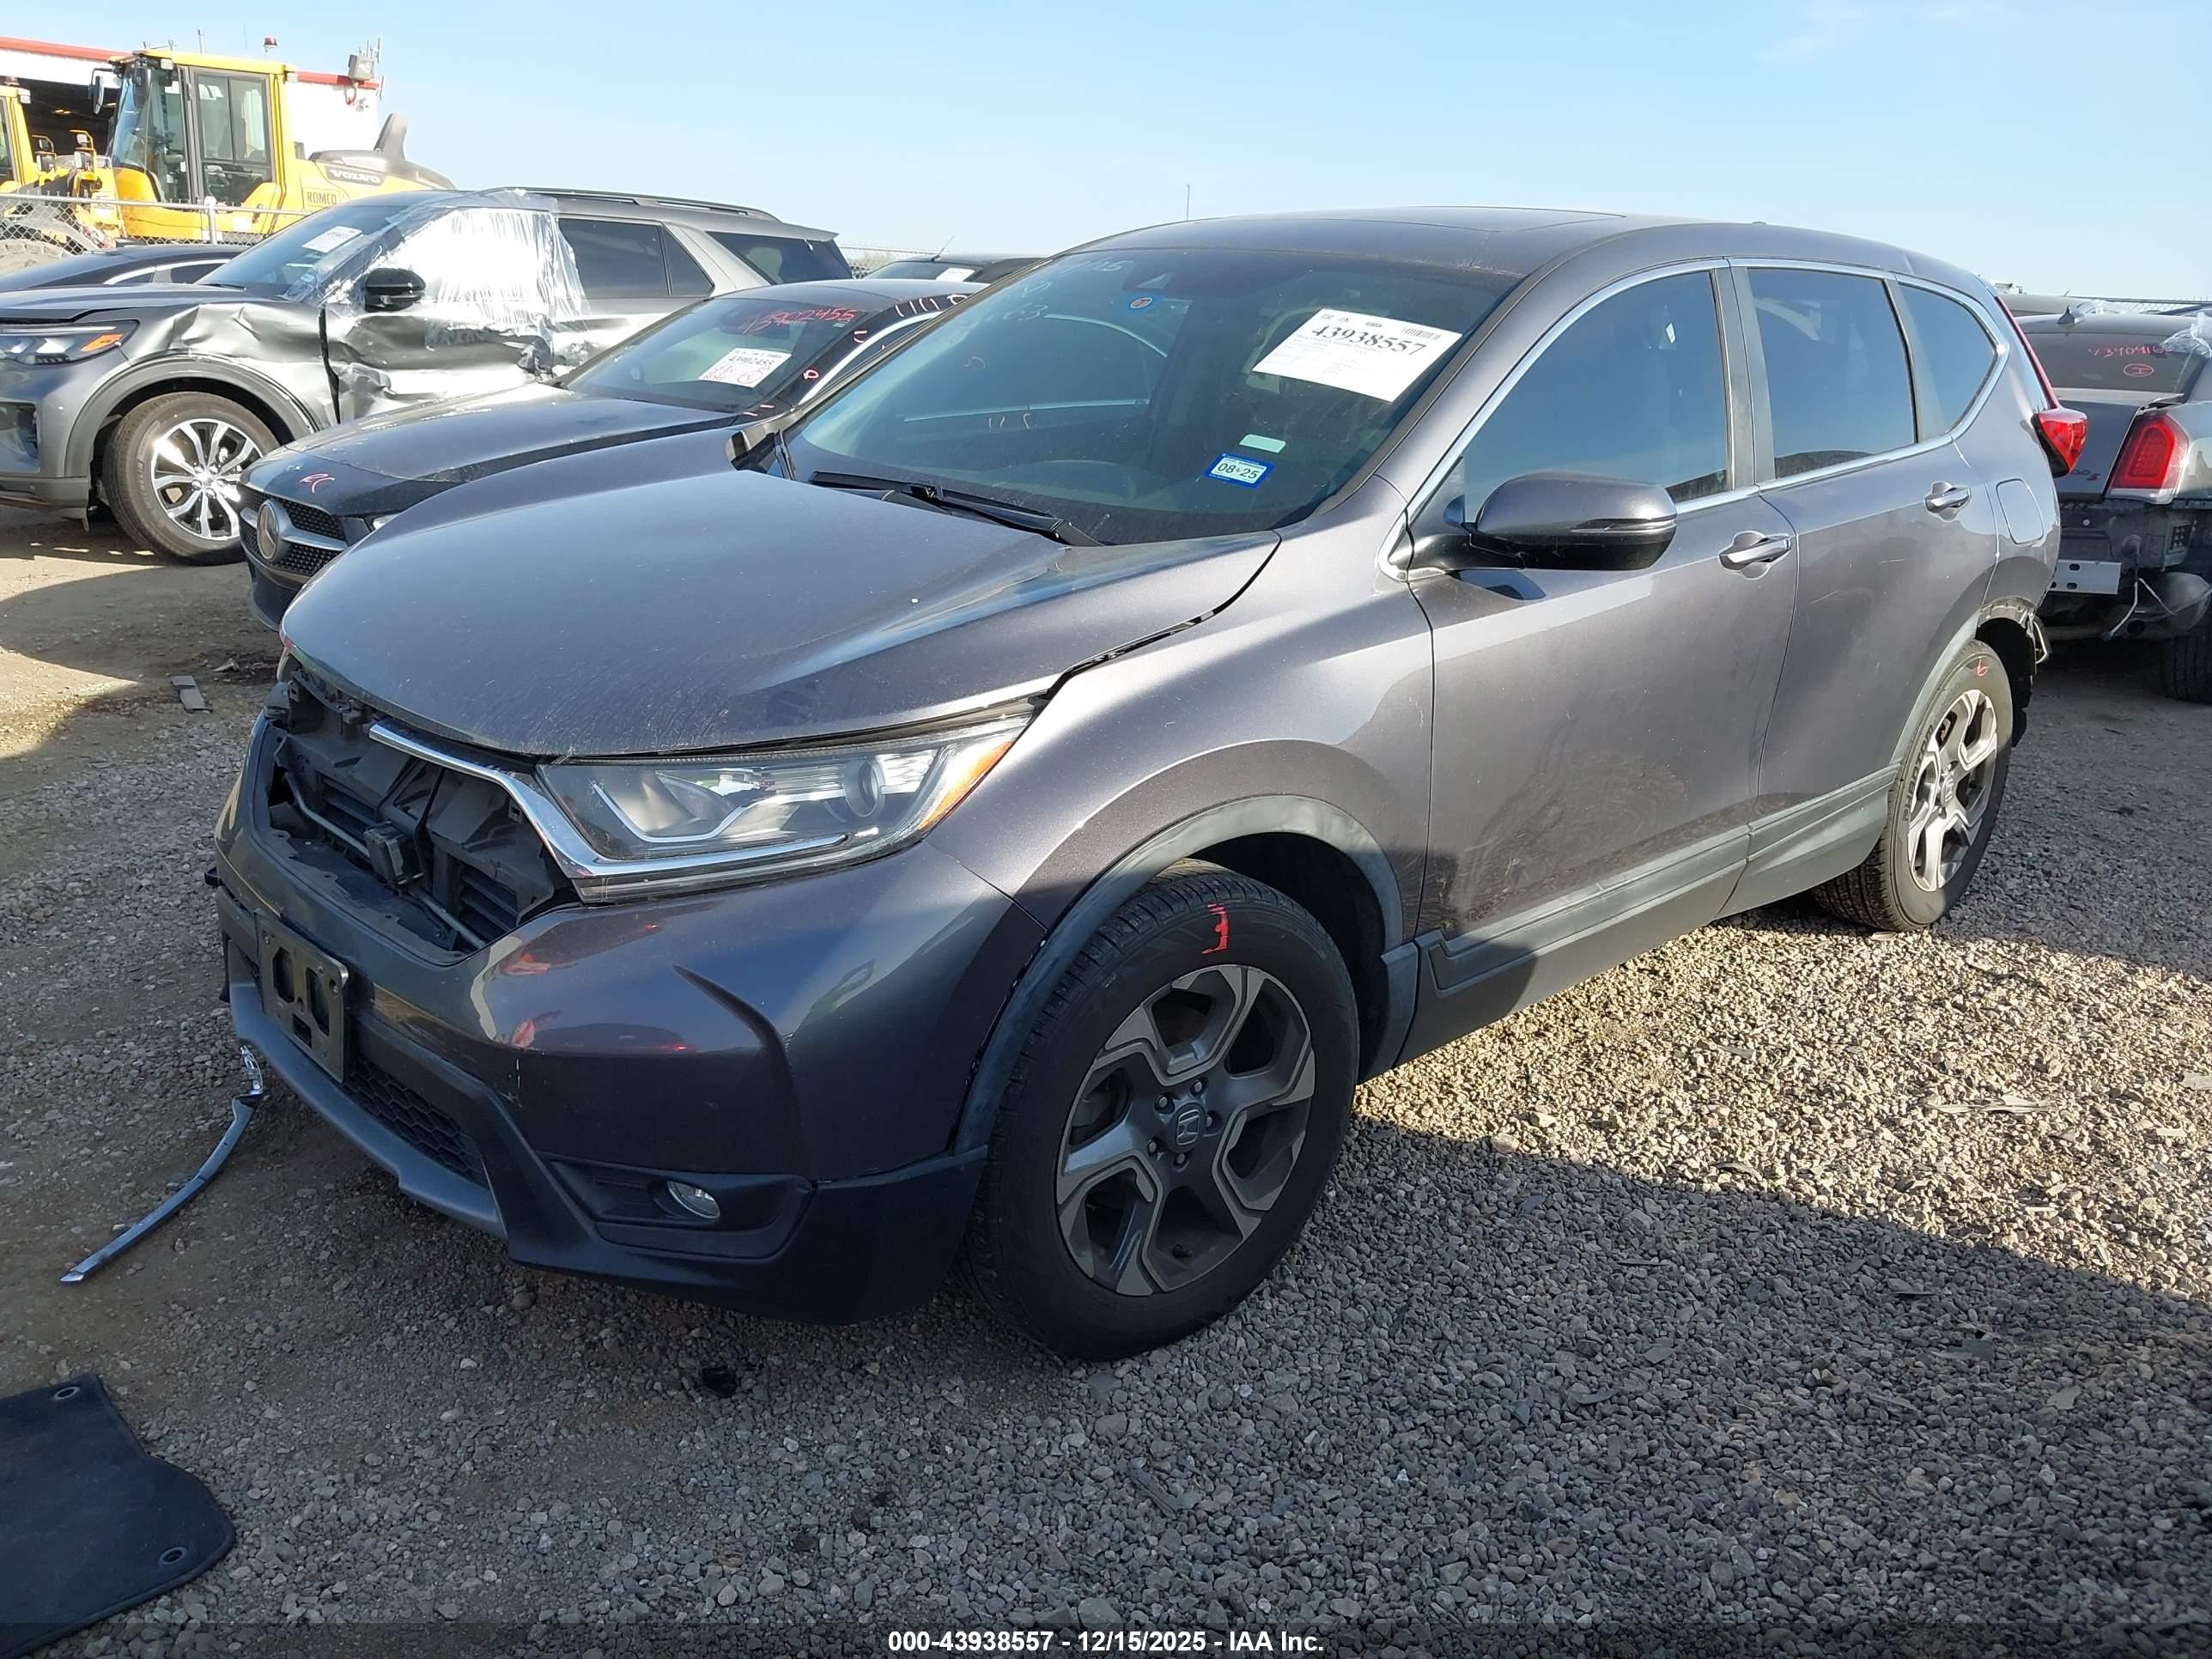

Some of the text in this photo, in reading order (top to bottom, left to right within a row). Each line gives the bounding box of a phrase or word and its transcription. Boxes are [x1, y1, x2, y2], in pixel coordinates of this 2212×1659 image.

[329, 168, 381, 184] VOLVO
[307, 191, 337, 205] ROMCO
[1312, 325, 1427, 356] 43938557
